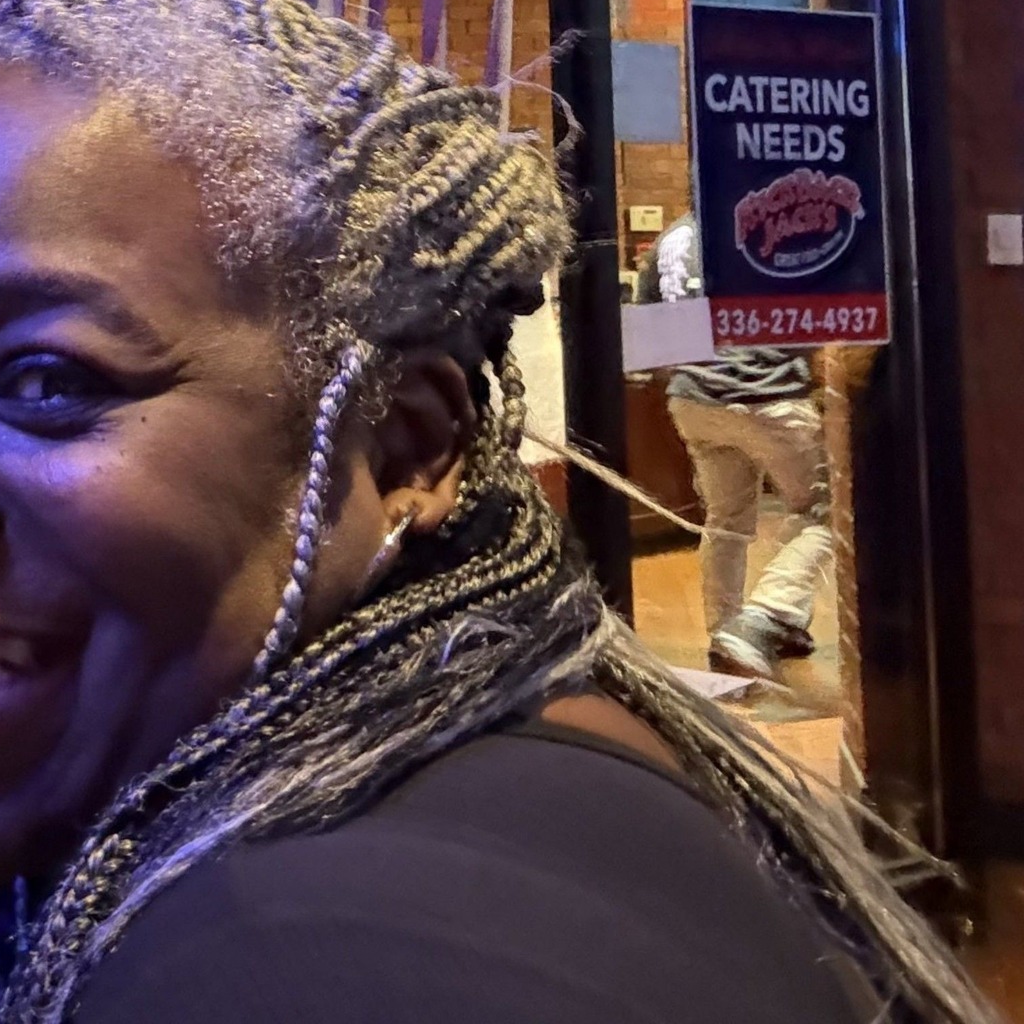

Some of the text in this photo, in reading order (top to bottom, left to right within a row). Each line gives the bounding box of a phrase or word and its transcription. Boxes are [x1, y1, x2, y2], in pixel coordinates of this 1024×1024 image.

[705, 74, 870, 117] CATERING
[736, 122, 846, 163] NEEDS
[716, 306, 878, 335] 336-274-4937
